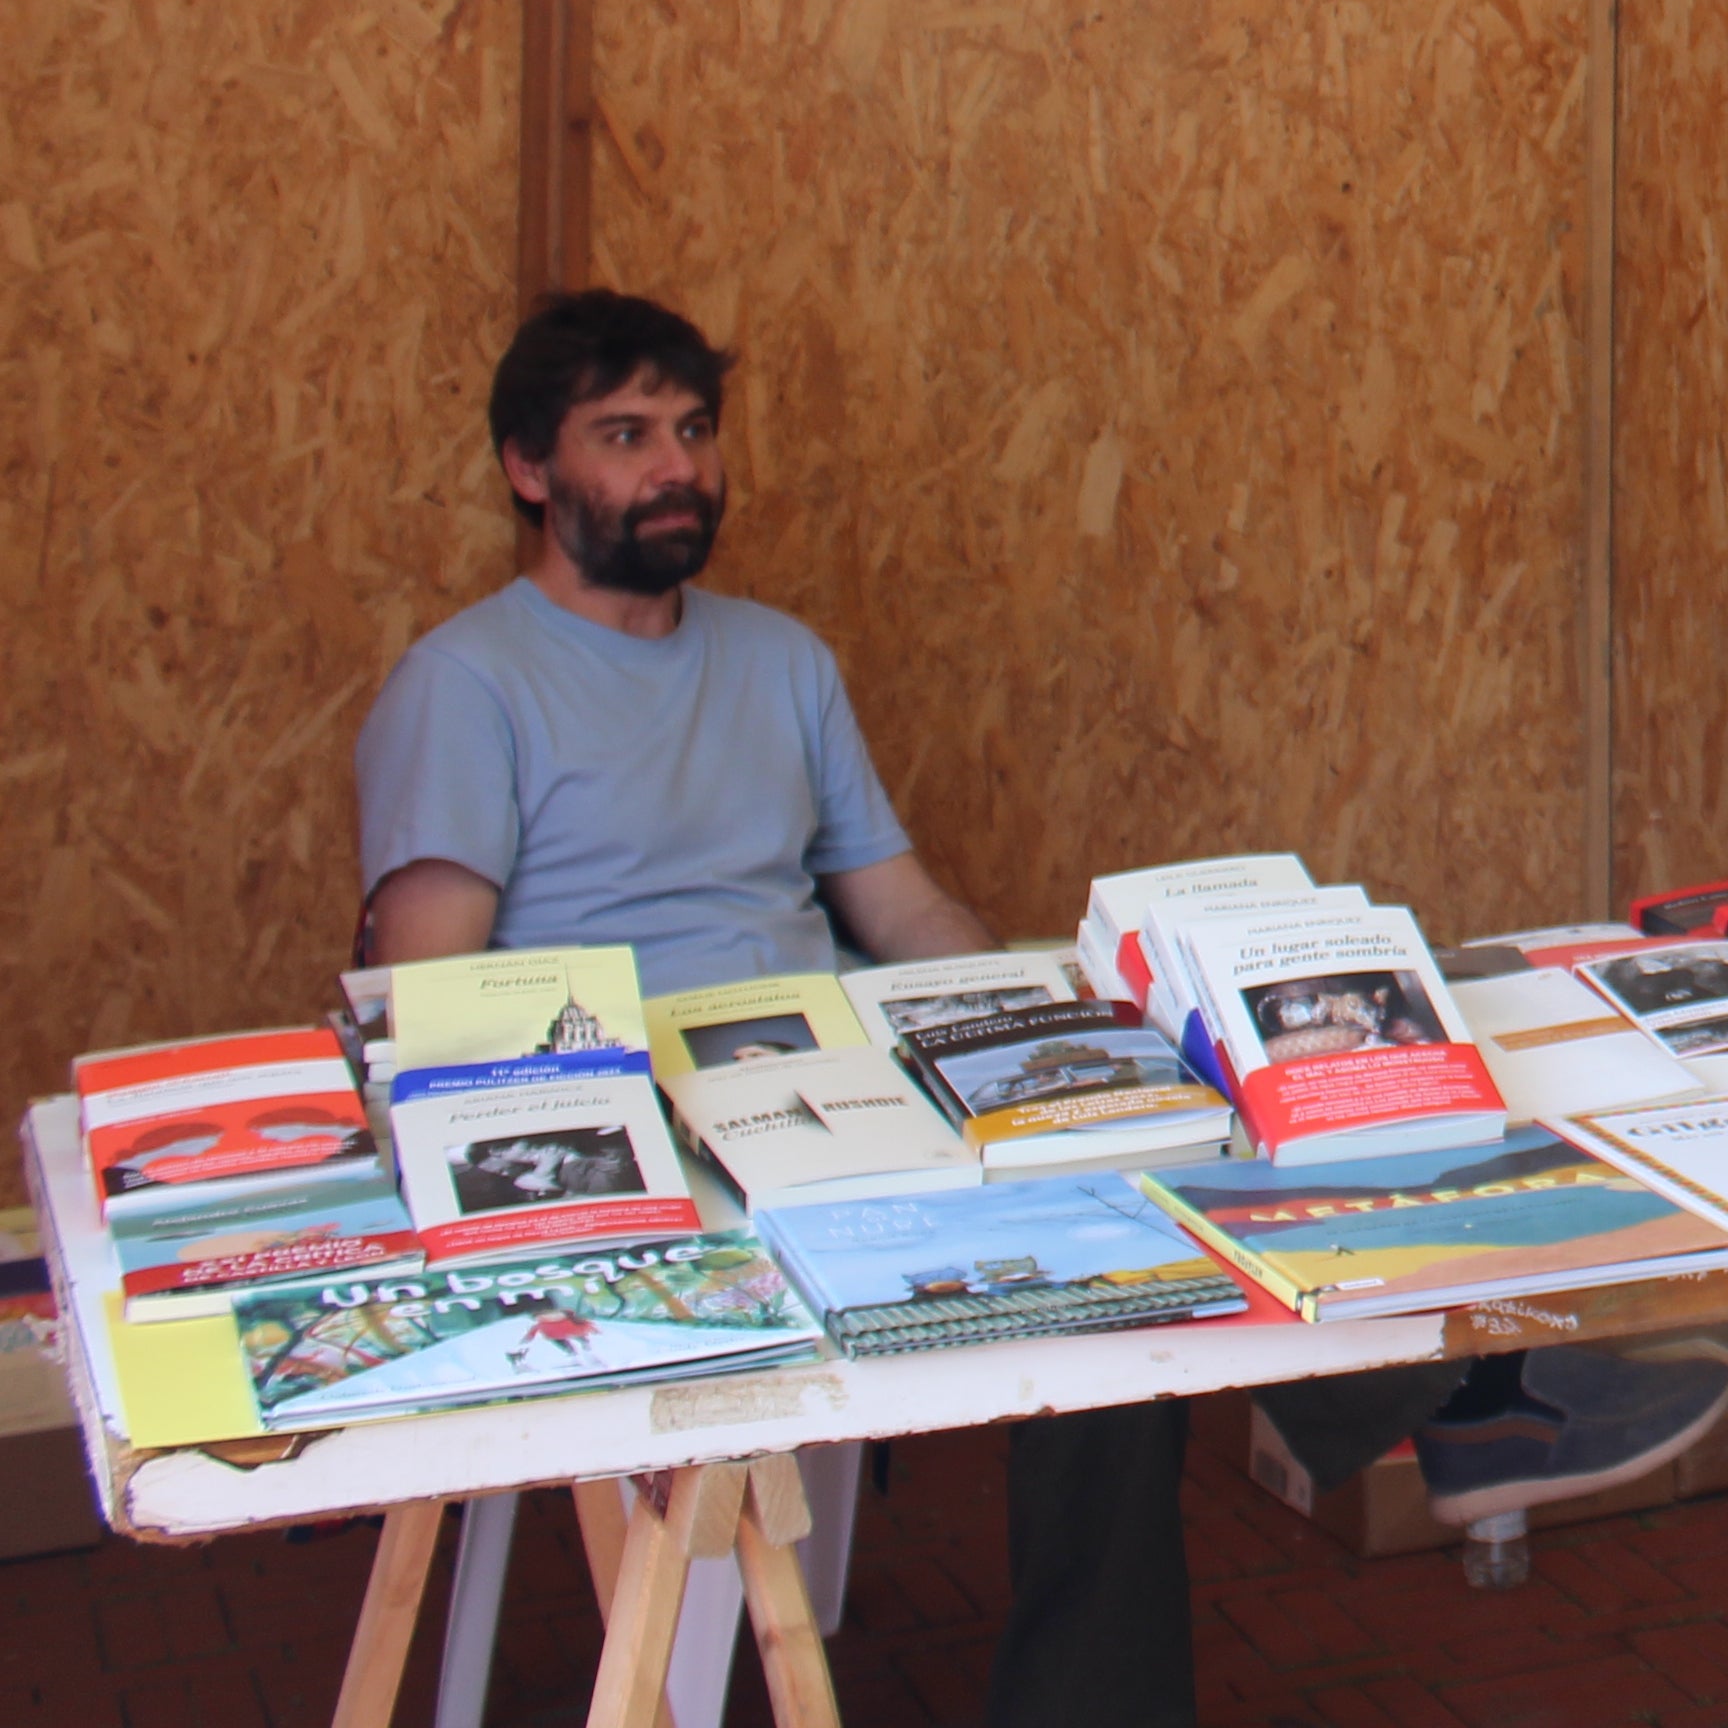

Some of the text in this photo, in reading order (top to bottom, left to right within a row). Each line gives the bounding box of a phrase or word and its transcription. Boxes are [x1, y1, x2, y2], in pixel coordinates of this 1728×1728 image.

[1239, 933, 1393, 960] Un lugar soleado
[1232, 957, 1275, 977] para
[1278, 950, 1331, 967] gente
[711, 1106, 803, 1134] SALMAN
[446, 1244, 712, 1296] bosque
[387, 1296, 482, 1319] en
